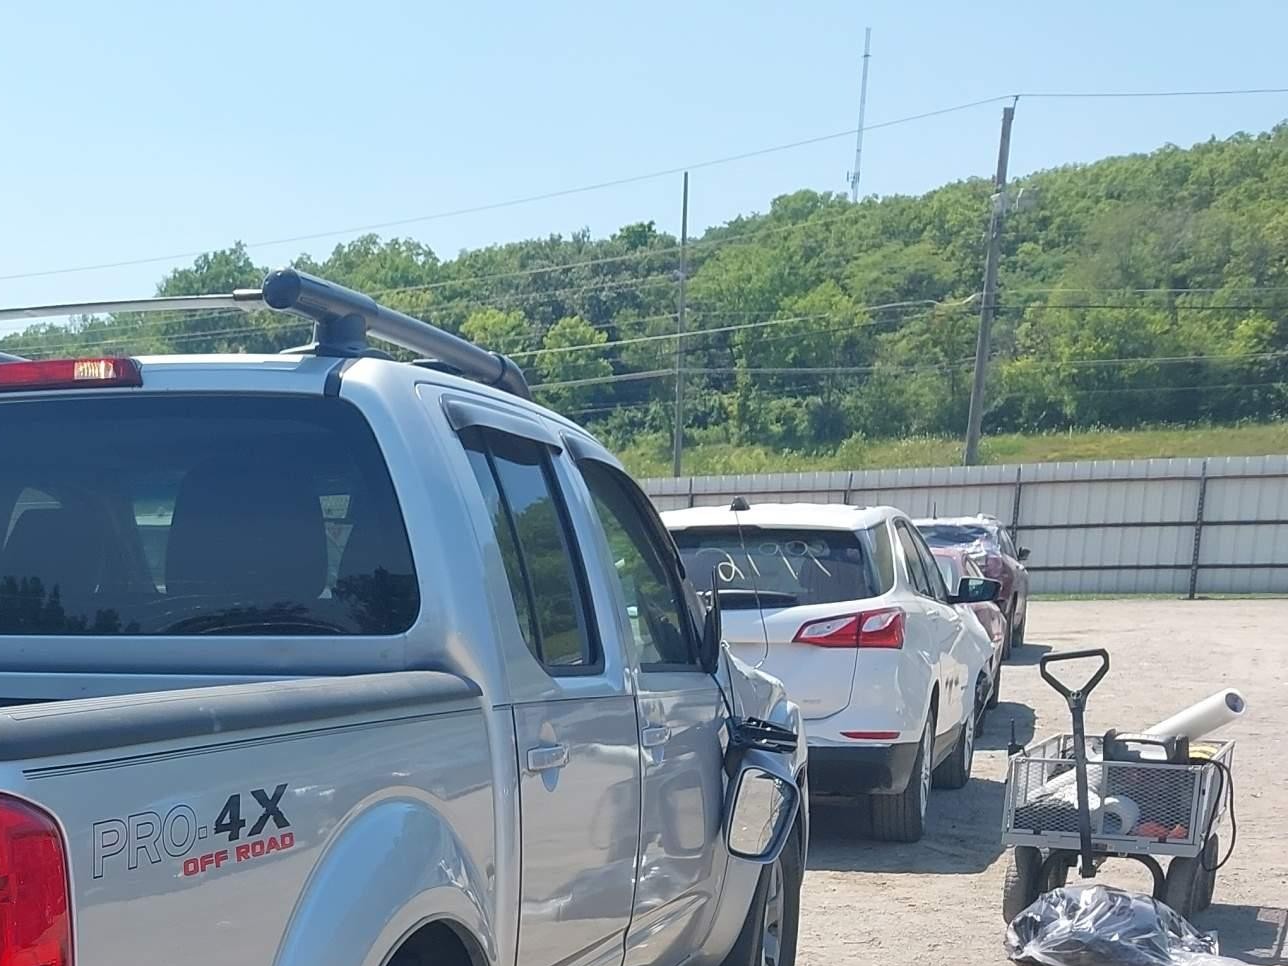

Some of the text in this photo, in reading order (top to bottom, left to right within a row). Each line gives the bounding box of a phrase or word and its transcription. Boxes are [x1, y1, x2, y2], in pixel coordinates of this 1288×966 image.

[92, 782, 291, 880] PRO-4X
[183, 832, 296, 877] OFF ROAD
